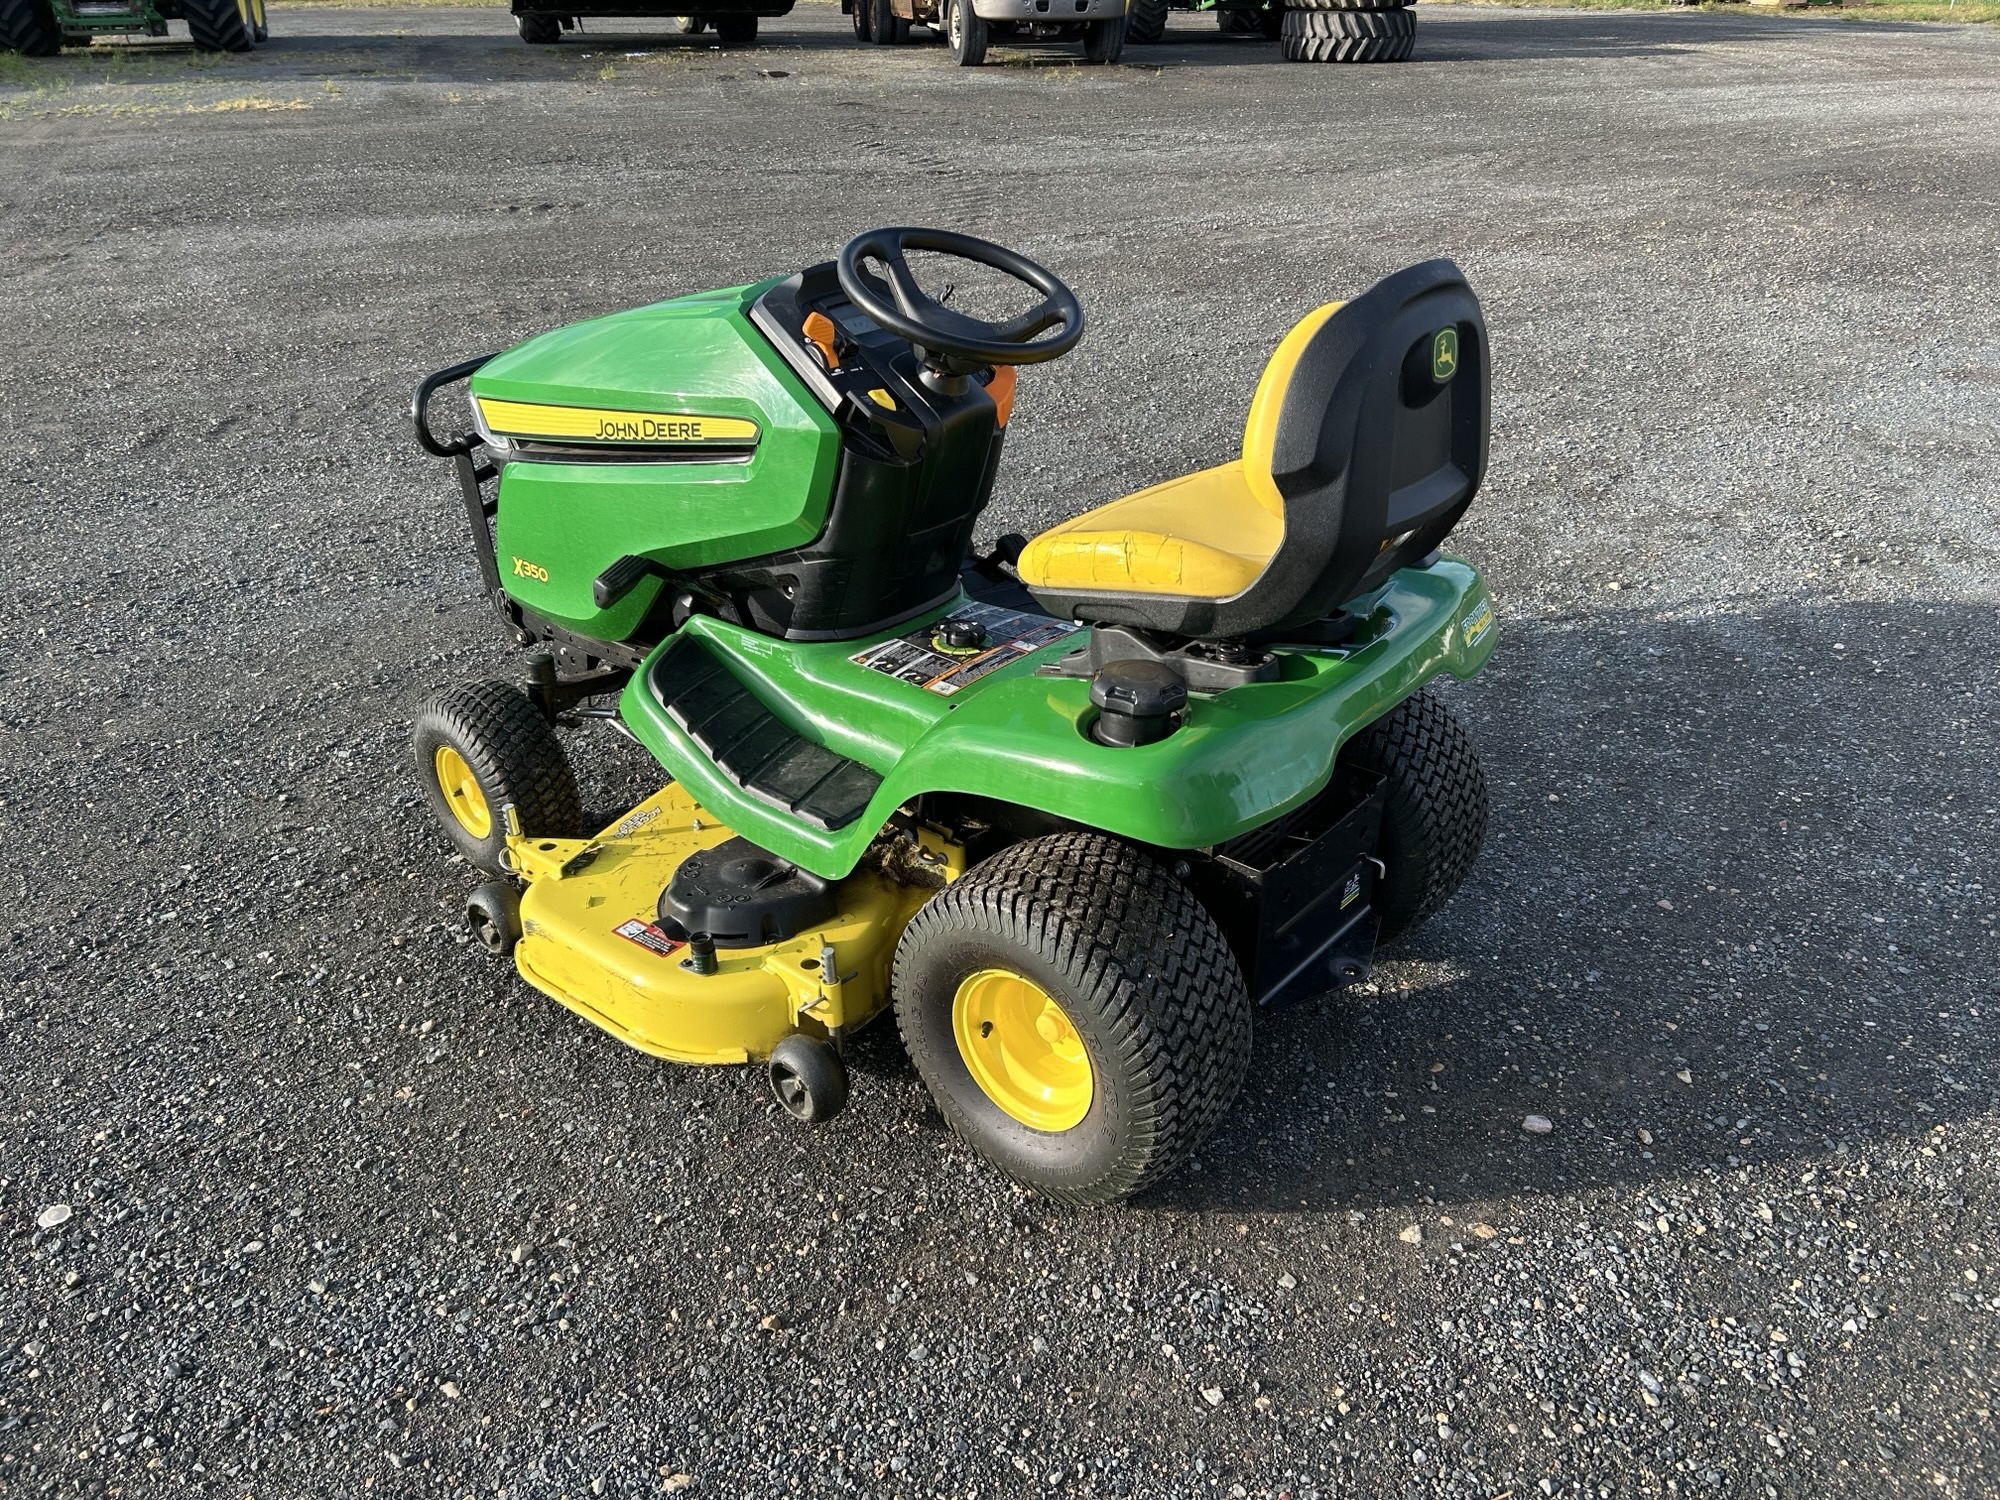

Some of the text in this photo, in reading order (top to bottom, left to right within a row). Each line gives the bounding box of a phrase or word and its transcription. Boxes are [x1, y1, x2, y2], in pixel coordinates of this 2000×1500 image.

[595, 418, 702, 438] JOHN DEERE
[512, 555, 549, 583] X350
[1051, 986, 1120, 1146] CARLISLE
[928, 1071, 980, 1136] MULTI
